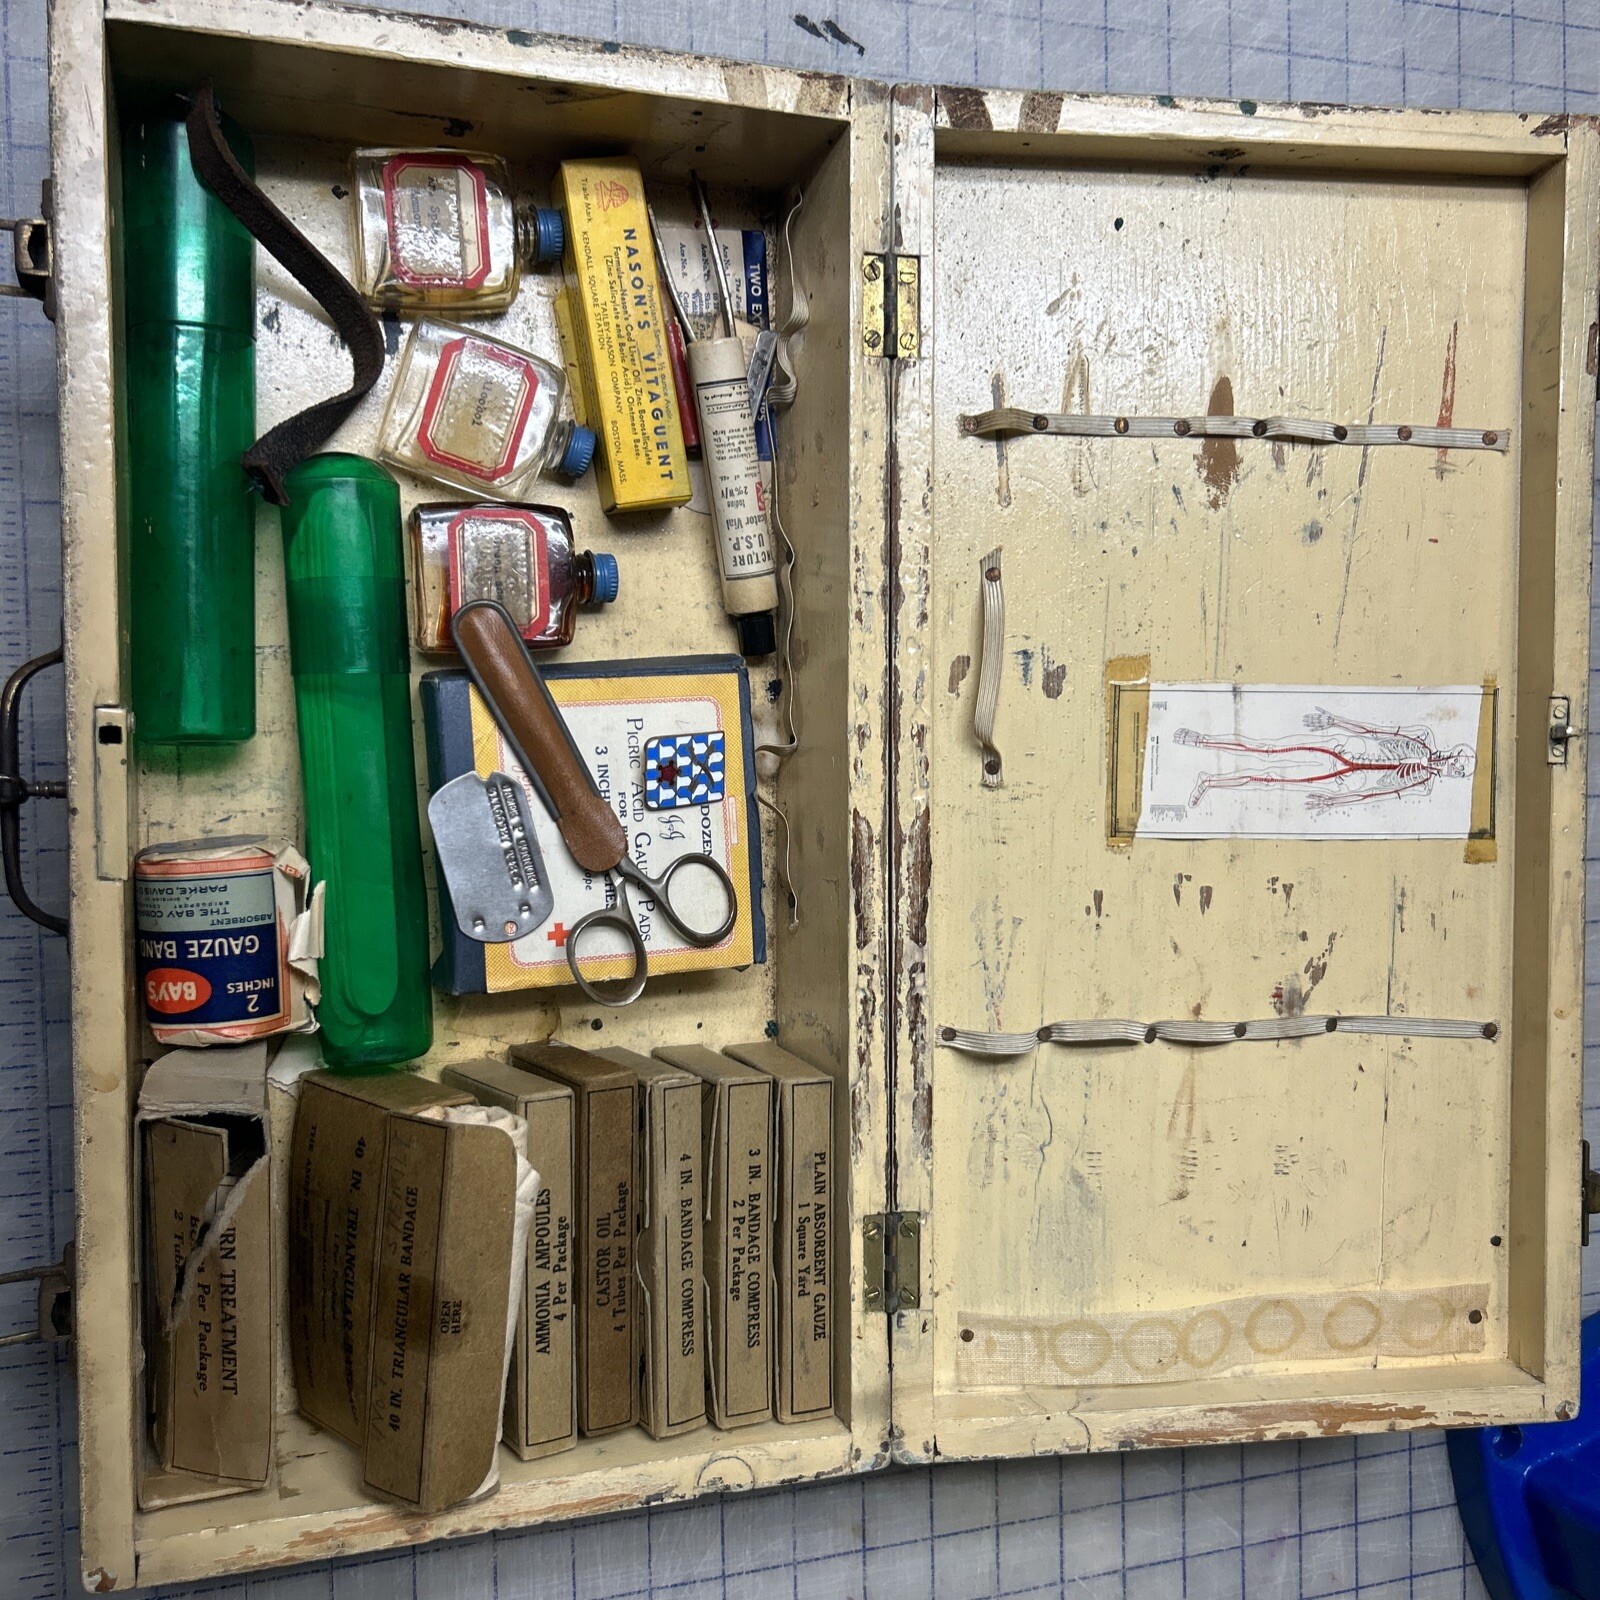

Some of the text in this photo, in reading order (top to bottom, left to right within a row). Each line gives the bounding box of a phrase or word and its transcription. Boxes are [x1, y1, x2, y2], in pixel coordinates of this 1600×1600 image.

[581, 177, 594, 223] Trade Mark
[700, 244, 708, 258] Ace
[722, 244, 730, 259] Ace
[582, 230, 606, 352] KENDALL SQUARE STATION
[749, 263, 762, 298] TWO
[607, 280, 621, 320] Salicylate
[751, 303, 762, 328] EXT
[614, 323, 624, 339] and
[626, 324, 636, 342] Cod
[600, 301, 624, 415] TAILBY-NASON COMPANY
[618, 342, 628, 364] Boric
[623, 228, 674, 481] NASON'S VITAGUENT
[628, 346, 640, 370] Liver
[635, 388, 643, 406] Zinc
[626, 396, 638, 436] Ointment
[610, 420, 627, 486] BOSTON, MASS.
[632, 438, 642, 461] Base.
[638, 409, 653, 466] Borosalicylate
[726, 517, 743, 531] Vial
[595, 746, 608, 757] 3
[597, 764, 611, 802] INCH
[618, 792, 627, 819] FOR
[634, 832, 652, 890] GAU
[144, 884, 228, 896] PARKE, DAVIS
[167, 910, 195, 918] BAY
[199, 907, 230, 917] THE
[209, 913, 273, 926] ABSORBENT
[140, 934, 260, 959] GAUZE BAND
[147, 980, 197, 1003] BAY'S
[226, 977, 274, 994] INCHES
[246, 994, 260, 1012] 2
[349, 1169, 363, 1194] IN.
[680, 1153, 695, 1357] 4 IN. BANDAGE COMPRESS
[730, 1199, 745, 1301] 2 Per Package
[747, 1148, 761, 1349] 3 IN. BANDAGE COMPRESS
[796, 1216, 810, 1260] Square
[813, 1151, 827, 1341] PLAIN ABSORBENT GAUZE
[343, 1208, 360, 1331] TRIANGULAR
[534, 1188, 551, 1356] AMMONIA AMPOULES
[553, 1216, 569, 1322] 4 Per Package
[596, 1212, 611, 1307] CASTOR OIL
[613, 1181, 629, 1333] 4 Tubes Per Package
[197, 1281, 212, 1312] Per
[798, 1264, 810, 1298] Yard
[388, 1186, 420, 1433] 40 IN. TRIANGULAR BANDAGE
[440, 1300, 452, 1334] OPEN
[451, 1299, 463, 1334] HERE
[220, 1268, 238, 1396] TREATMENT
[196, 1319, 213, 1392] Package
